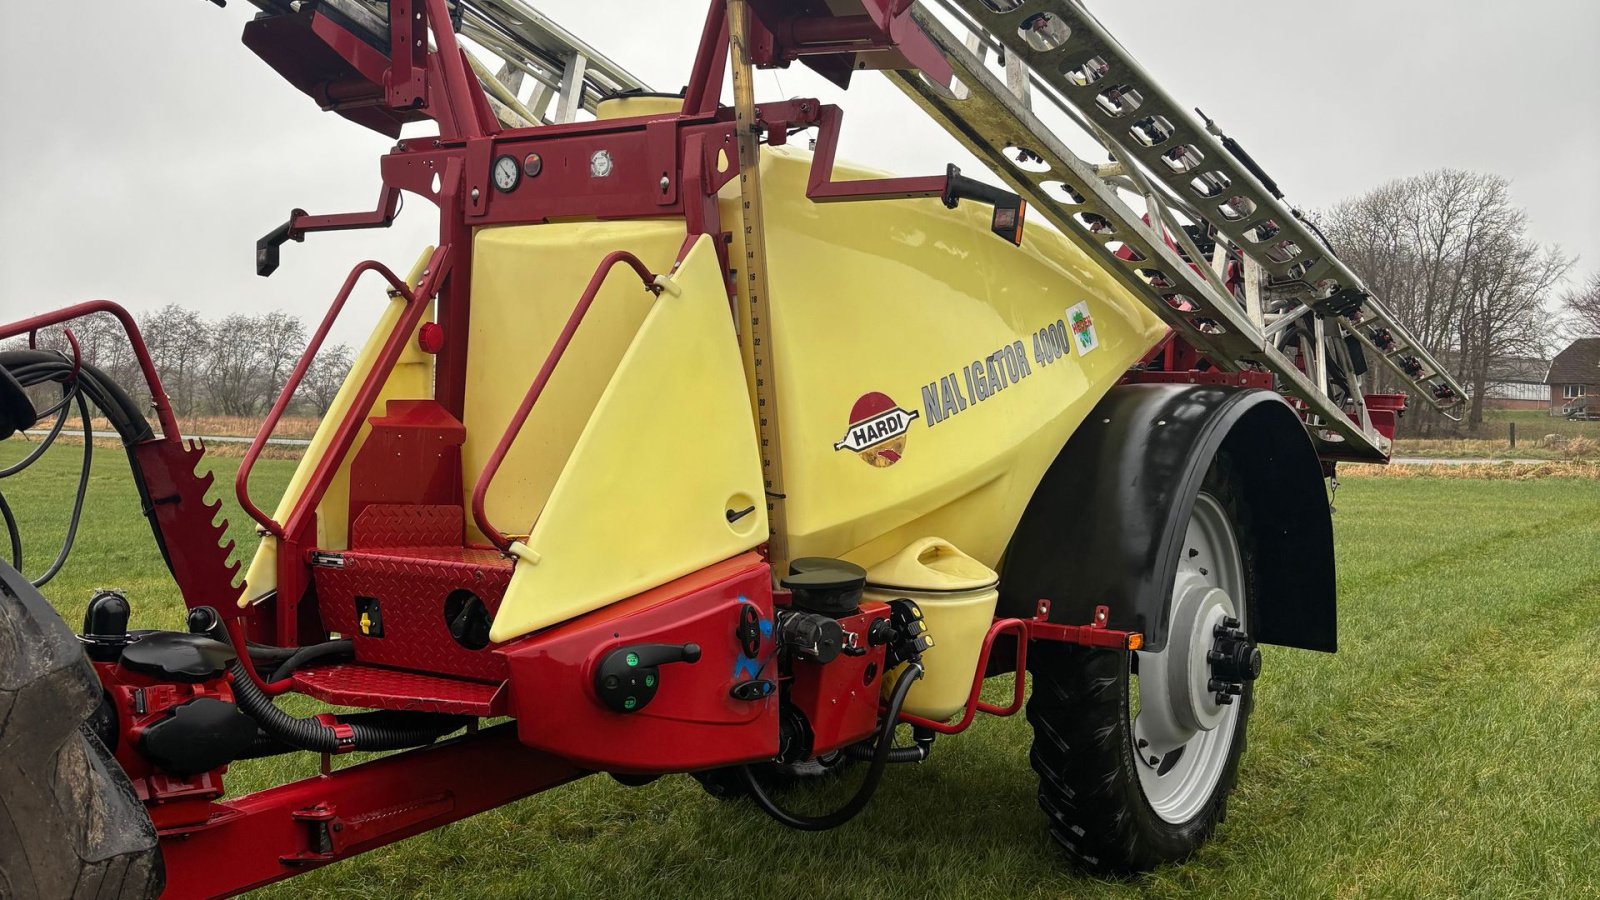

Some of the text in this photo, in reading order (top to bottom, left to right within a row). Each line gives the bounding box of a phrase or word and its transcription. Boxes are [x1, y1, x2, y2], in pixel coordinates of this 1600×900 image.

[744, 201, 750, 209] 10
[752, 317, 759, 325] 20
[754, 338, 760, 346] 22
[1032, 319, 1070, 368] 4000
[757, 378, 763, 386] 26
[759, 398, 765, 406] 28
[760, 418, 767, 426] 30
[852, 413, 904, 447] HARDI
[764, 459, 770, 467] 34
[766, 480, 772, 488] 36
